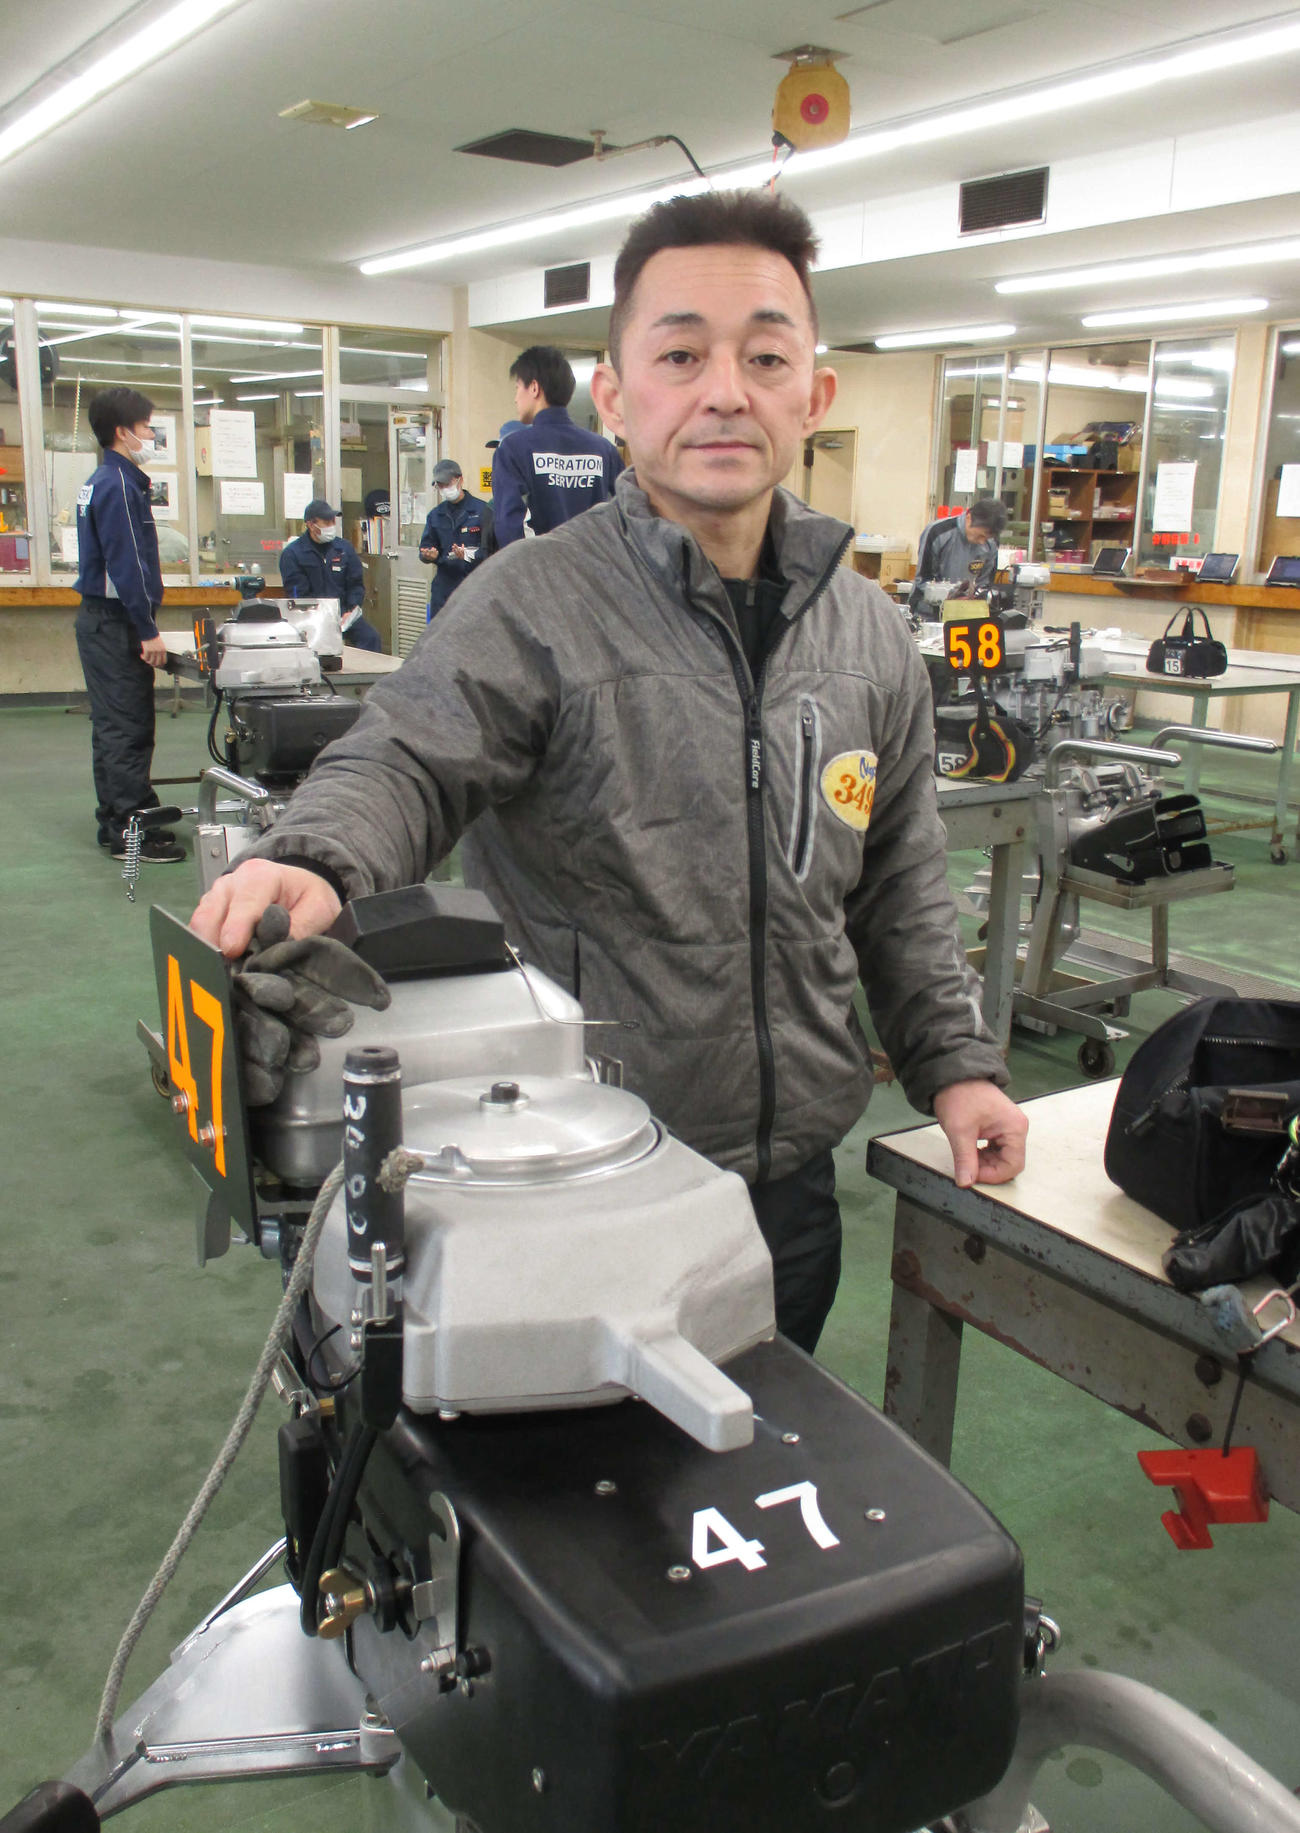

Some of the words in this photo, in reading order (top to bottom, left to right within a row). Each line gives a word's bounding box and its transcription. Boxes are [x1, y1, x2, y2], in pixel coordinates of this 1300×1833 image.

[535, 457, 603, 471] OPERATION
[548, 473, 595, 488] SERVICE
[949, 623, 1001, 669] 58
[1166, 660, 1180, 673] 15
[751, 738, 761, 789] FieldCore
[167, 954, 228, 1178] 47
[692, 1480, 841, 1571] 47
